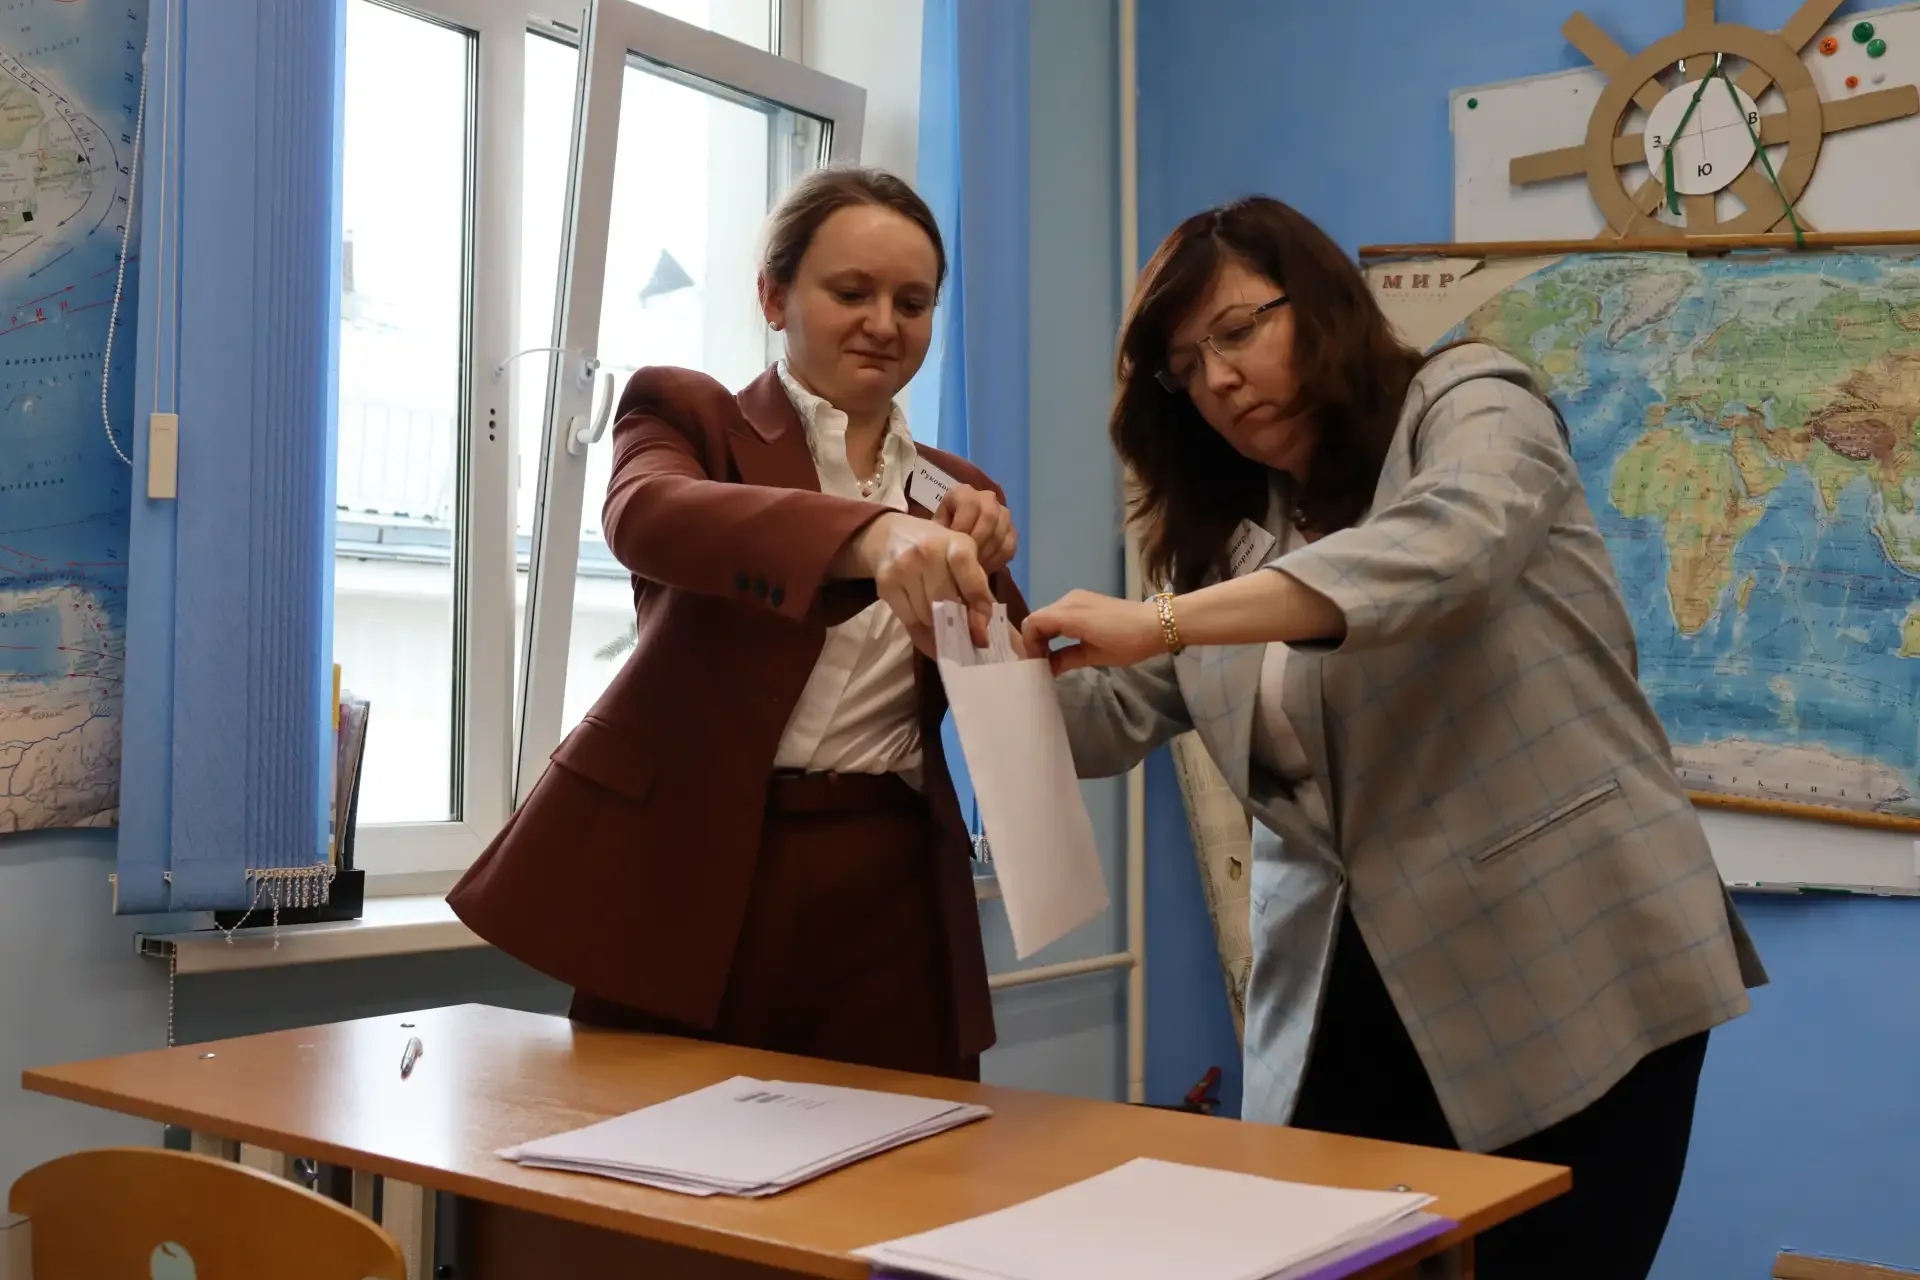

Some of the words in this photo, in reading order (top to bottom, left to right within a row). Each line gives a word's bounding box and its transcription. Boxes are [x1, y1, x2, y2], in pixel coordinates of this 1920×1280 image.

[1748, 111, 1758, 125] В
[1652, 135, 1661, 148] З
[1697, 163, 1713, 177] Ю
[1382, 273, 1455, 289] МИР
[1232, 543, 1255, 574] тории
